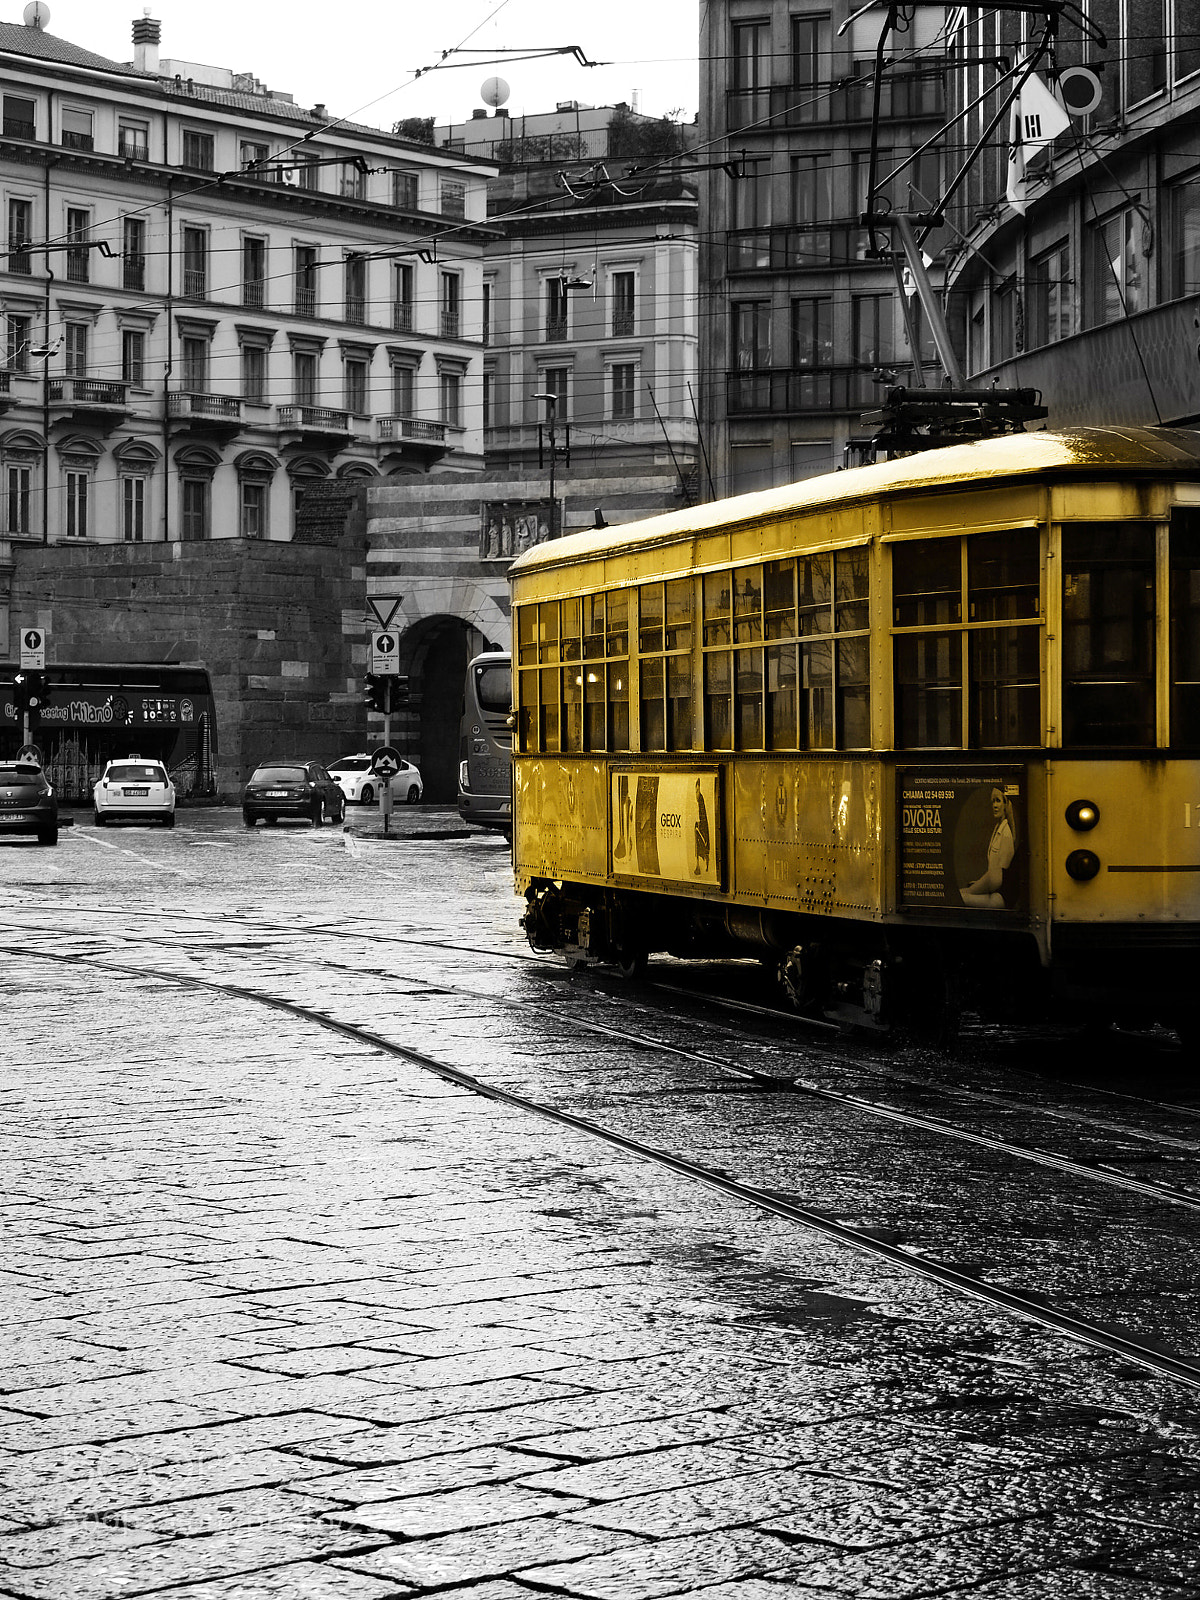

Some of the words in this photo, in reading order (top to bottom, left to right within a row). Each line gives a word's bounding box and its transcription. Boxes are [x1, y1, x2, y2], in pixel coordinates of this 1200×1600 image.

[70, 701, 113, 723] Milano
[902, 790, 924, 800] CHIAMA
[924, 790, 931, 800] 02
[931, 790, 938, 800] 54
[945, 790, 955, 800] 593
[660, 813, 681, 828] GEOX
[903, 809, 942, 827] DVORA
